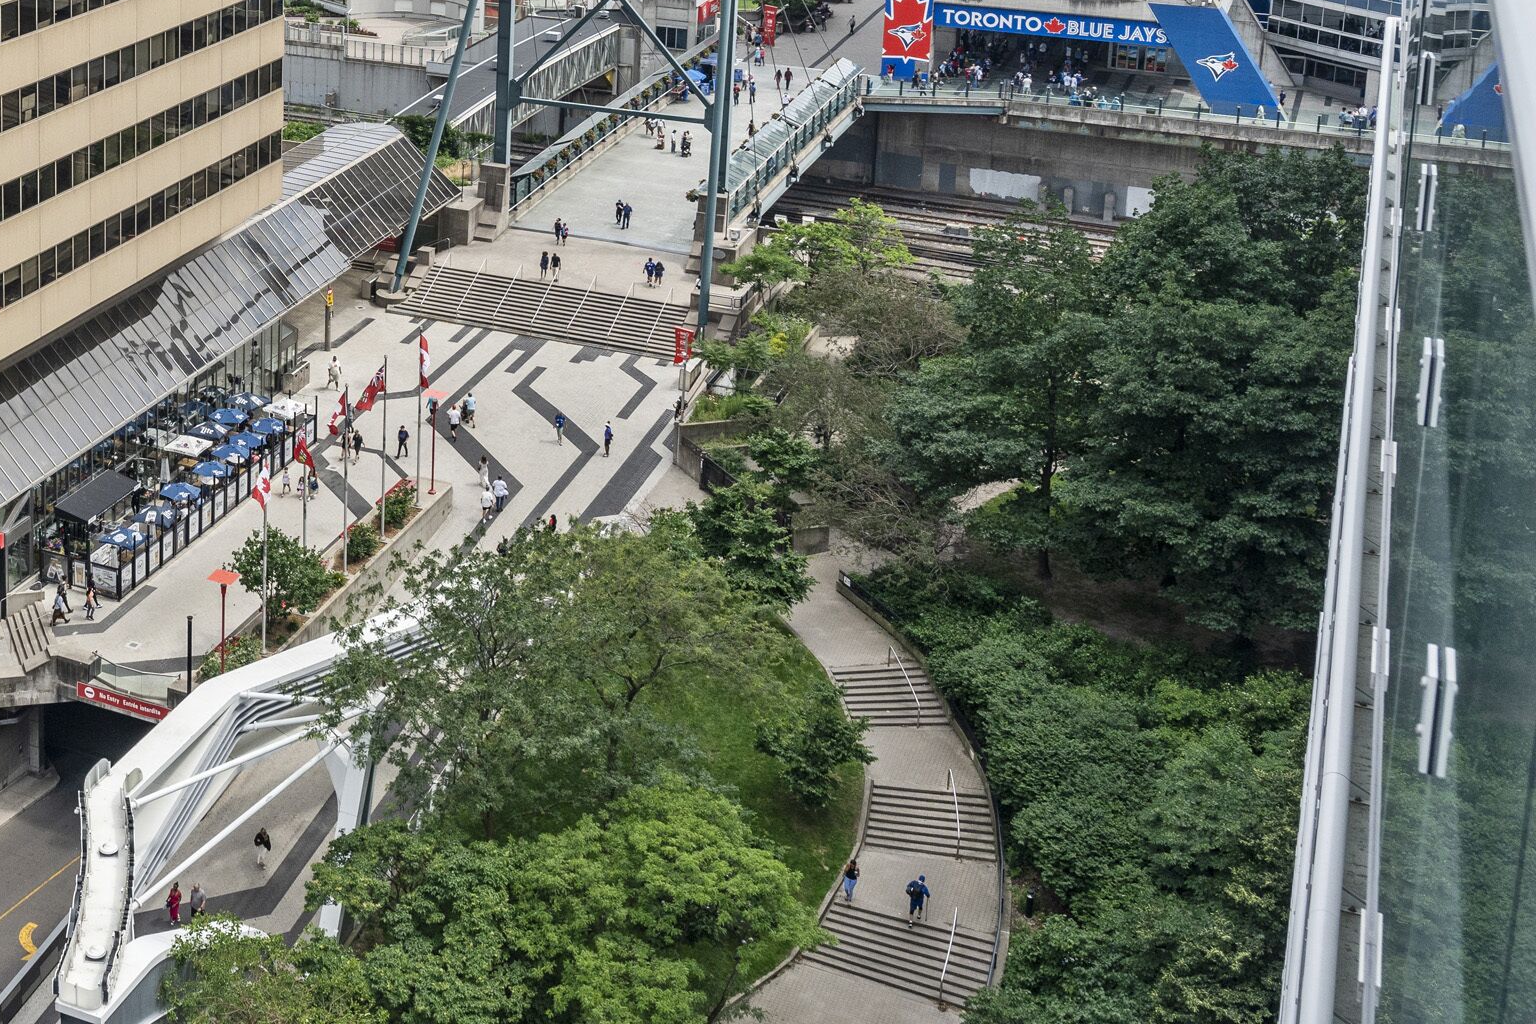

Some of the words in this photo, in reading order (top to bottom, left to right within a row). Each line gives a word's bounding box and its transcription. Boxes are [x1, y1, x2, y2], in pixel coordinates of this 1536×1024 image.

[943, 9, 1042, 32] TORONTO
[1067, 20, 1114, 39] BLUE
[1118, 25, 1167, 44] JAYS
[235, 396, 249, 405] Lite
[200, 426, 214, 435] Lite
[99, 692, 106, 700] No
[106, 694, 120, 705] Entry
[122, 699, 139, 710] Entrée
[139, 705, 161, 716] interdite
